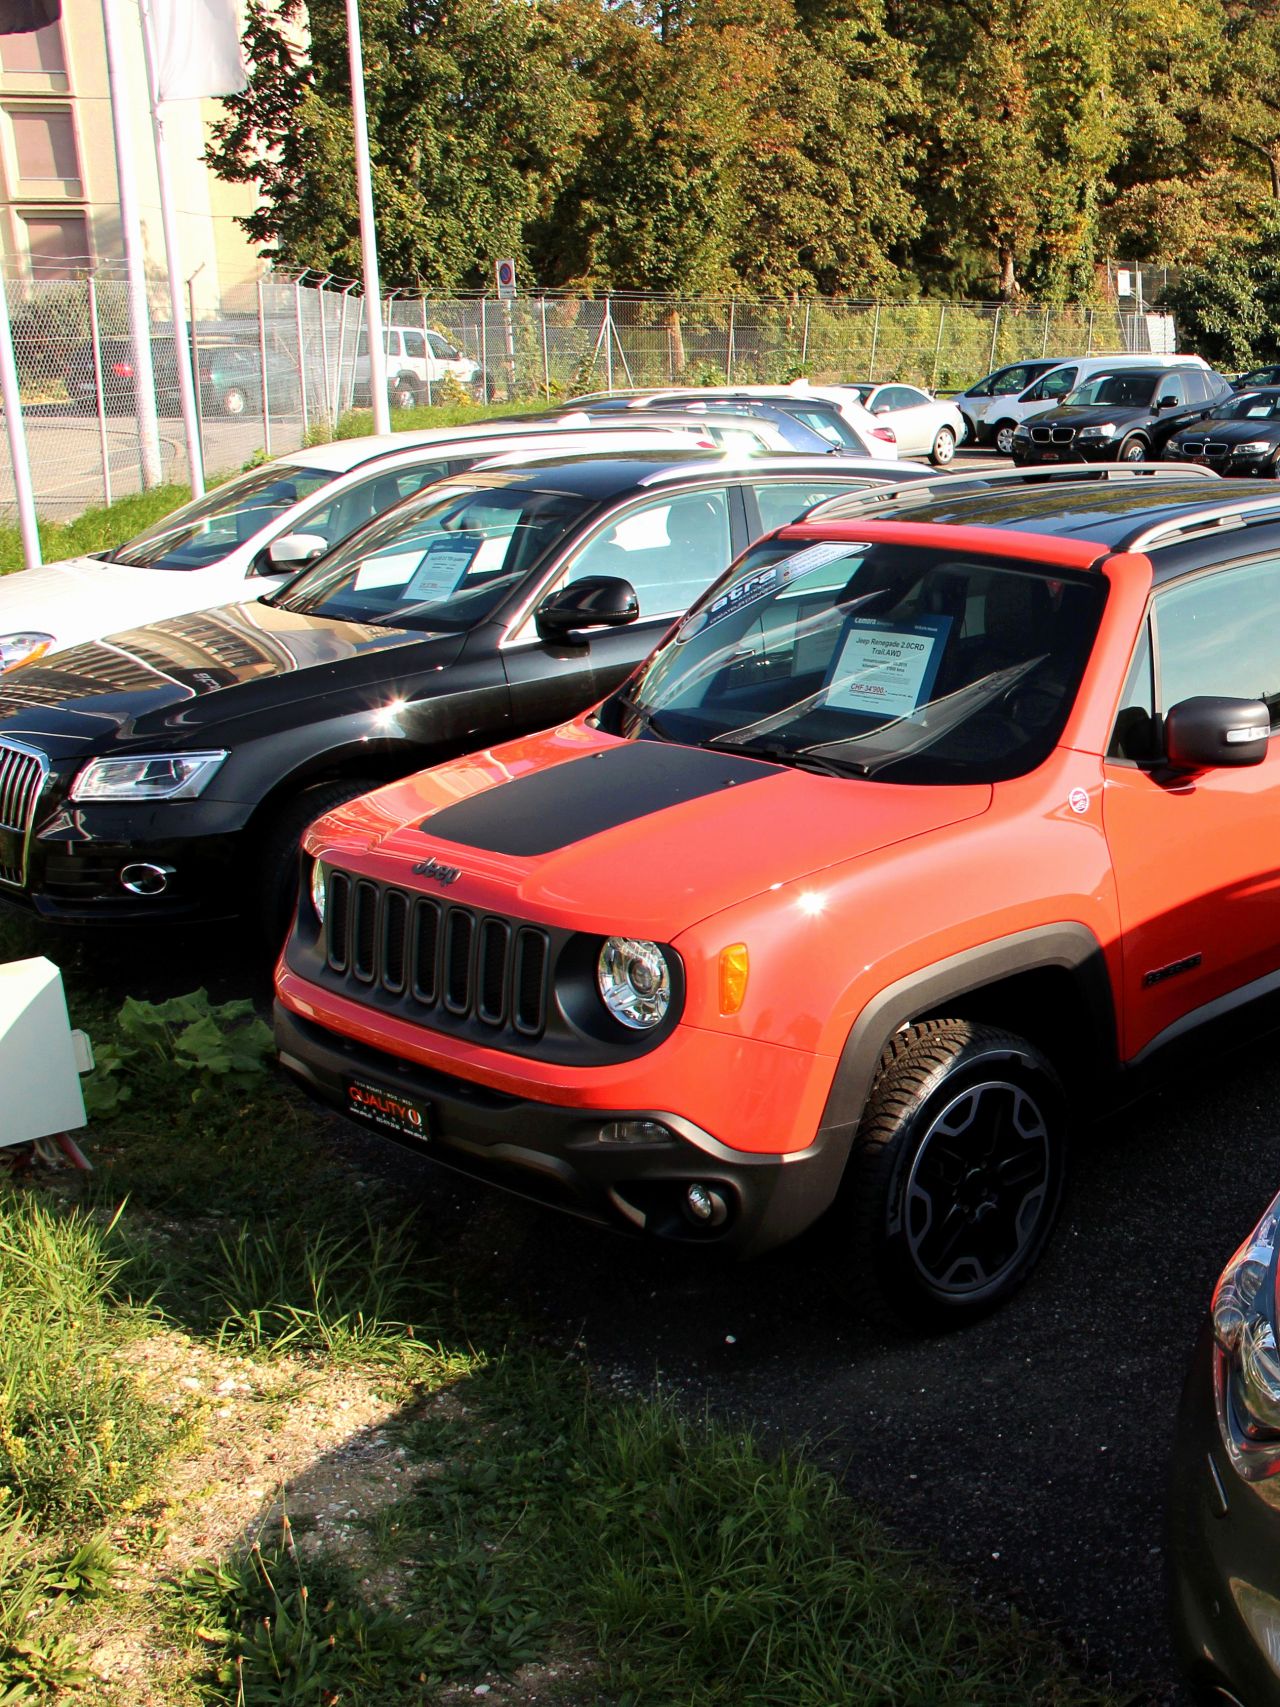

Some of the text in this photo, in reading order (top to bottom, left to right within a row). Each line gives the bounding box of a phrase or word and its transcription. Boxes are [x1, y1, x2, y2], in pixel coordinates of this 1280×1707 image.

[711, 568, 778, 613] atra
[856, 637, 925, 651] Jeep Renegade 2.0CRD
[850, 683, 864, 691] CHF
[412, 857, 462, 887] Jeep
[348, 1086, 406, 1118] QUALITY
